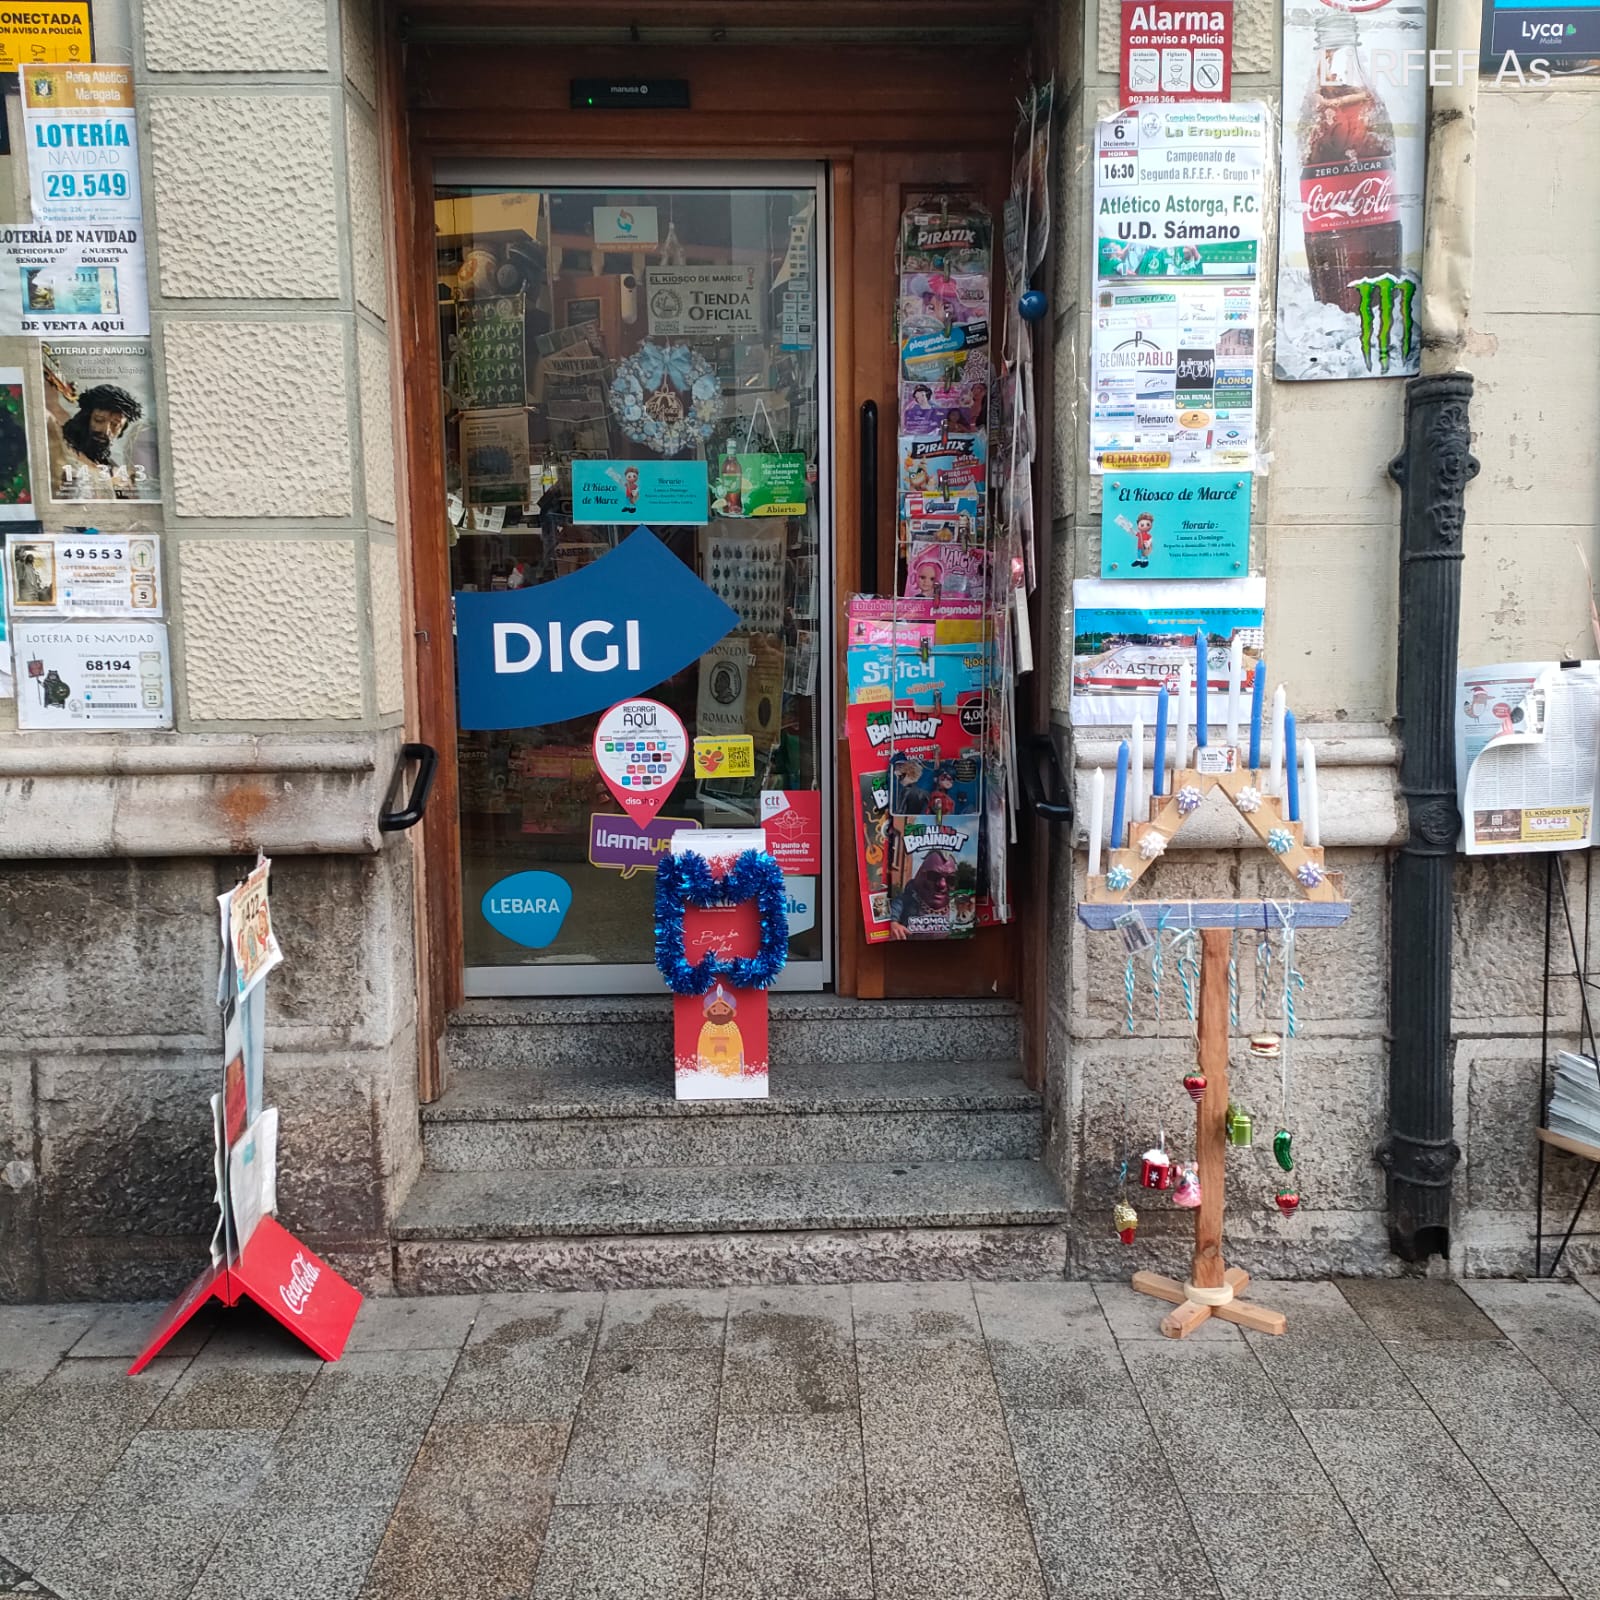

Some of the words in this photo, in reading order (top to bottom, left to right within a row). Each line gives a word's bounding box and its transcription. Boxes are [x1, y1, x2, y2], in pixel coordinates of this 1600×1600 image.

[1130, 6, 1224, 30] Alarma
[49, 26, 82, 35] POLICÍA
[1522, 21, 1564, 40] Lyca
[1130, 36, 1148, 44] con
[1150, 33, 1178, 44] aviso
[1180, 36, 1186, 44] a
[1190, 33, 1224, 44] Policía
[36, 120, 130, 148] LOTERÍA
[1114, 125, 1125, 140] 6
[1164, 126, 1184, 138] La
[1188, 126, 1262, 140] Eragudina
[48, 150, 120, 166] NAVIDAD
[1166, 150, 1222, 164] Campeonato
[1224, 150, 1236, 162] de
[1104, 164, 1134, 180] 16:30
[1140, 168, 1180, 182] Segunda
[1182, 168, 1215, 180] R.F.E.F.
[1222, 168, 1248, 182] Grupo
[1315, 167, 1340, 177] ZERO
[48, 173, 126, 198] 29.549
[1100, 194, 1160, 215] Atlético
[1164, 194, 1228, 218] Astorga,
[1232, 195, 1259, 214] F.C.
[1118, 222, 1157, 240] U.D.
[1164, 219, 1240, 240] Sámano
[56, 230, 74, 242] DE
[76, 230, 137, 244] NAVIDAD
[917, 230, 976, 246] PIRATIX
[689, 290, 750, 306] TIENDA
[688, 308, 752, 320] OFICIAL
[22, 321, 40, 331] DE
[42, 321, 88, 331] VENTA
[92, 318, 124, 332] AQUÍ
[50, 346, 87, 355] LOTERIA
[89, 346, 102, 355] DE
[103, 346, 145, 356] NAVIDAD
[1137, 351, 1174, 367] PABLO
[1216, 376, 1252, 384] ALONSO
[1136, 414, 1174, 424] Telenauto
[1106, 455, 1117, 463] EL
[1118, 454, 1167, 463] MARAGATO
[583, 483, 591, 492] El
[1118, 488, 1130, 502] El
[1132, 488, 1174, 502] Kiosco
[1178, 488, 1193, 501] de
[1197, 486, 1238, 501] Marce
[582, 496, 592, 505] de
[64, 548, 122, 559] 49553
[940, 546, 976, 574] NANCY
[76, 635, 90, 643] DE
[94, 634, 154, 644] NAVIDAD
[493, 620, 640, 674] DIGI
[86, 660, 131, 670] 68194
[867, 718, 941, 746] BRAINROT
[764, 796, 780, 806] ctt
[781, 842, 800, 851] punto
[904, 832, 968, 853] BRAINROT
[491, 898, 561, 914] LEBARA
